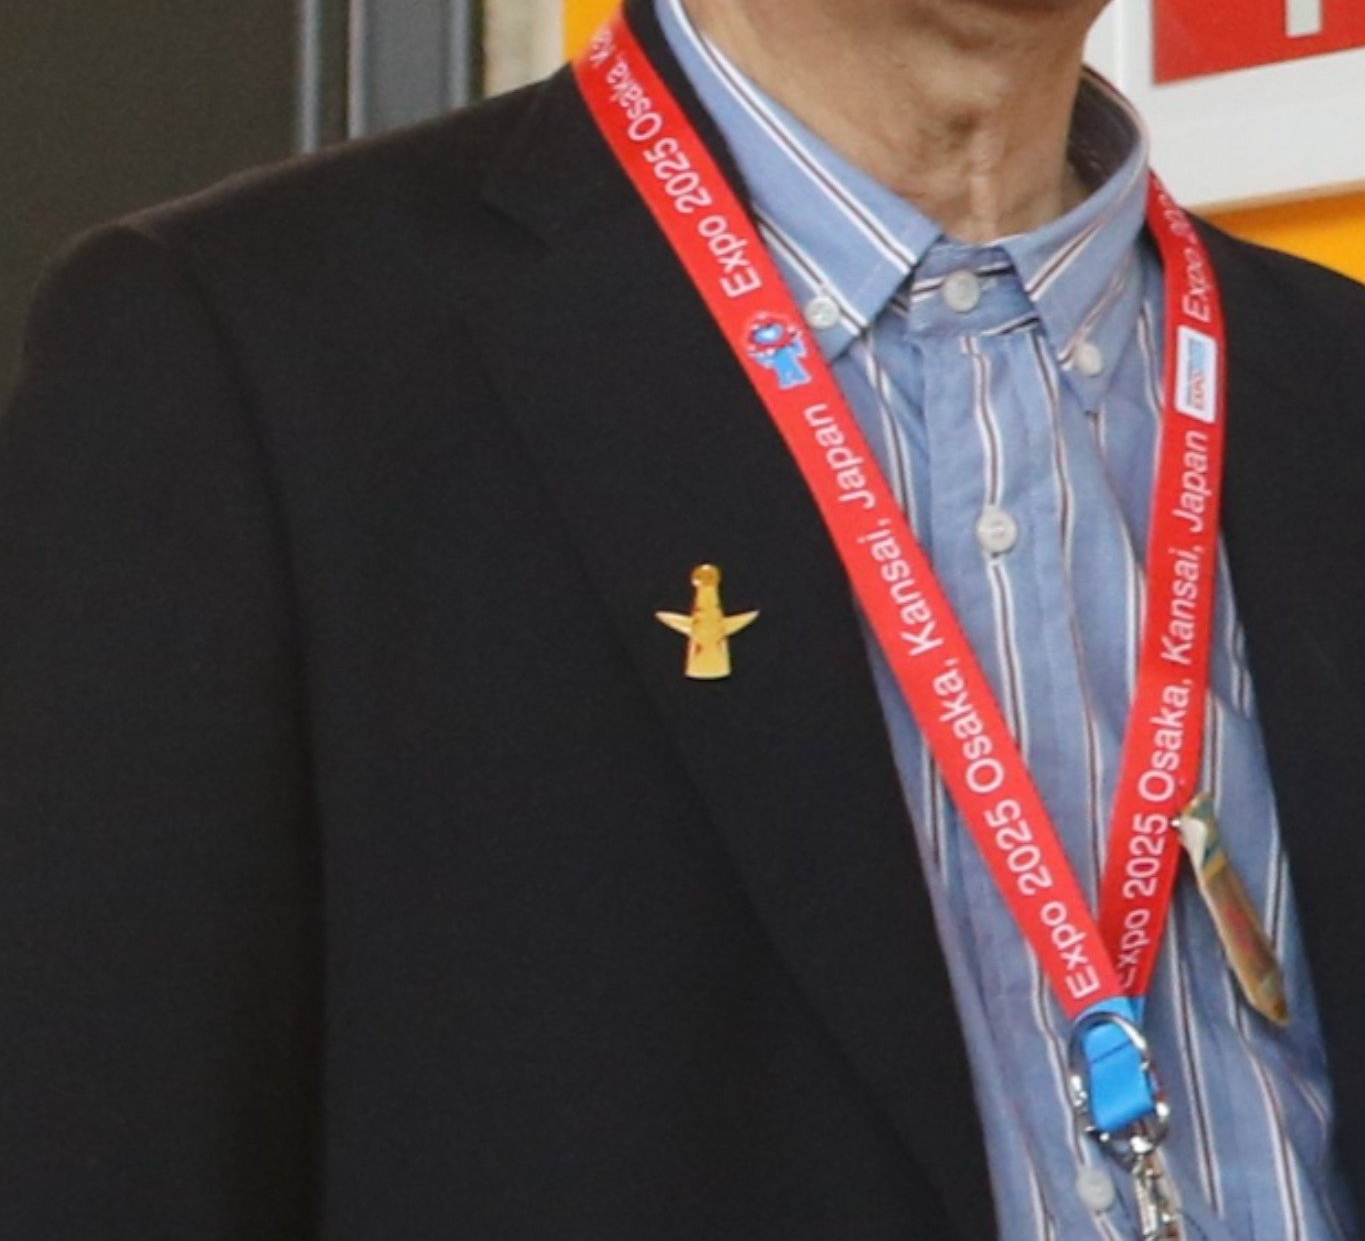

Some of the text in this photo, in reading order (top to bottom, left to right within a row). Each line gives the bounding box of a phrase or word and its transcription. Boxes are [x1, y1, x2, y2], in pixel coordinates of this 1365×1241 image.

[606, 55, 762, 298] Expo 2025 Osaka,
[1182, 247, 1211, 323] Expo
[1173, 430, 1212, 533] Japan
[1161, 545, 1205, 665] Kansai,
[806, 402, 1099, 998] Expo 2025 Osaka, Kansai, Japan
[1138, 678, 1192, 802] Osaka,
[1122, 813, 1168, 900] 2025
